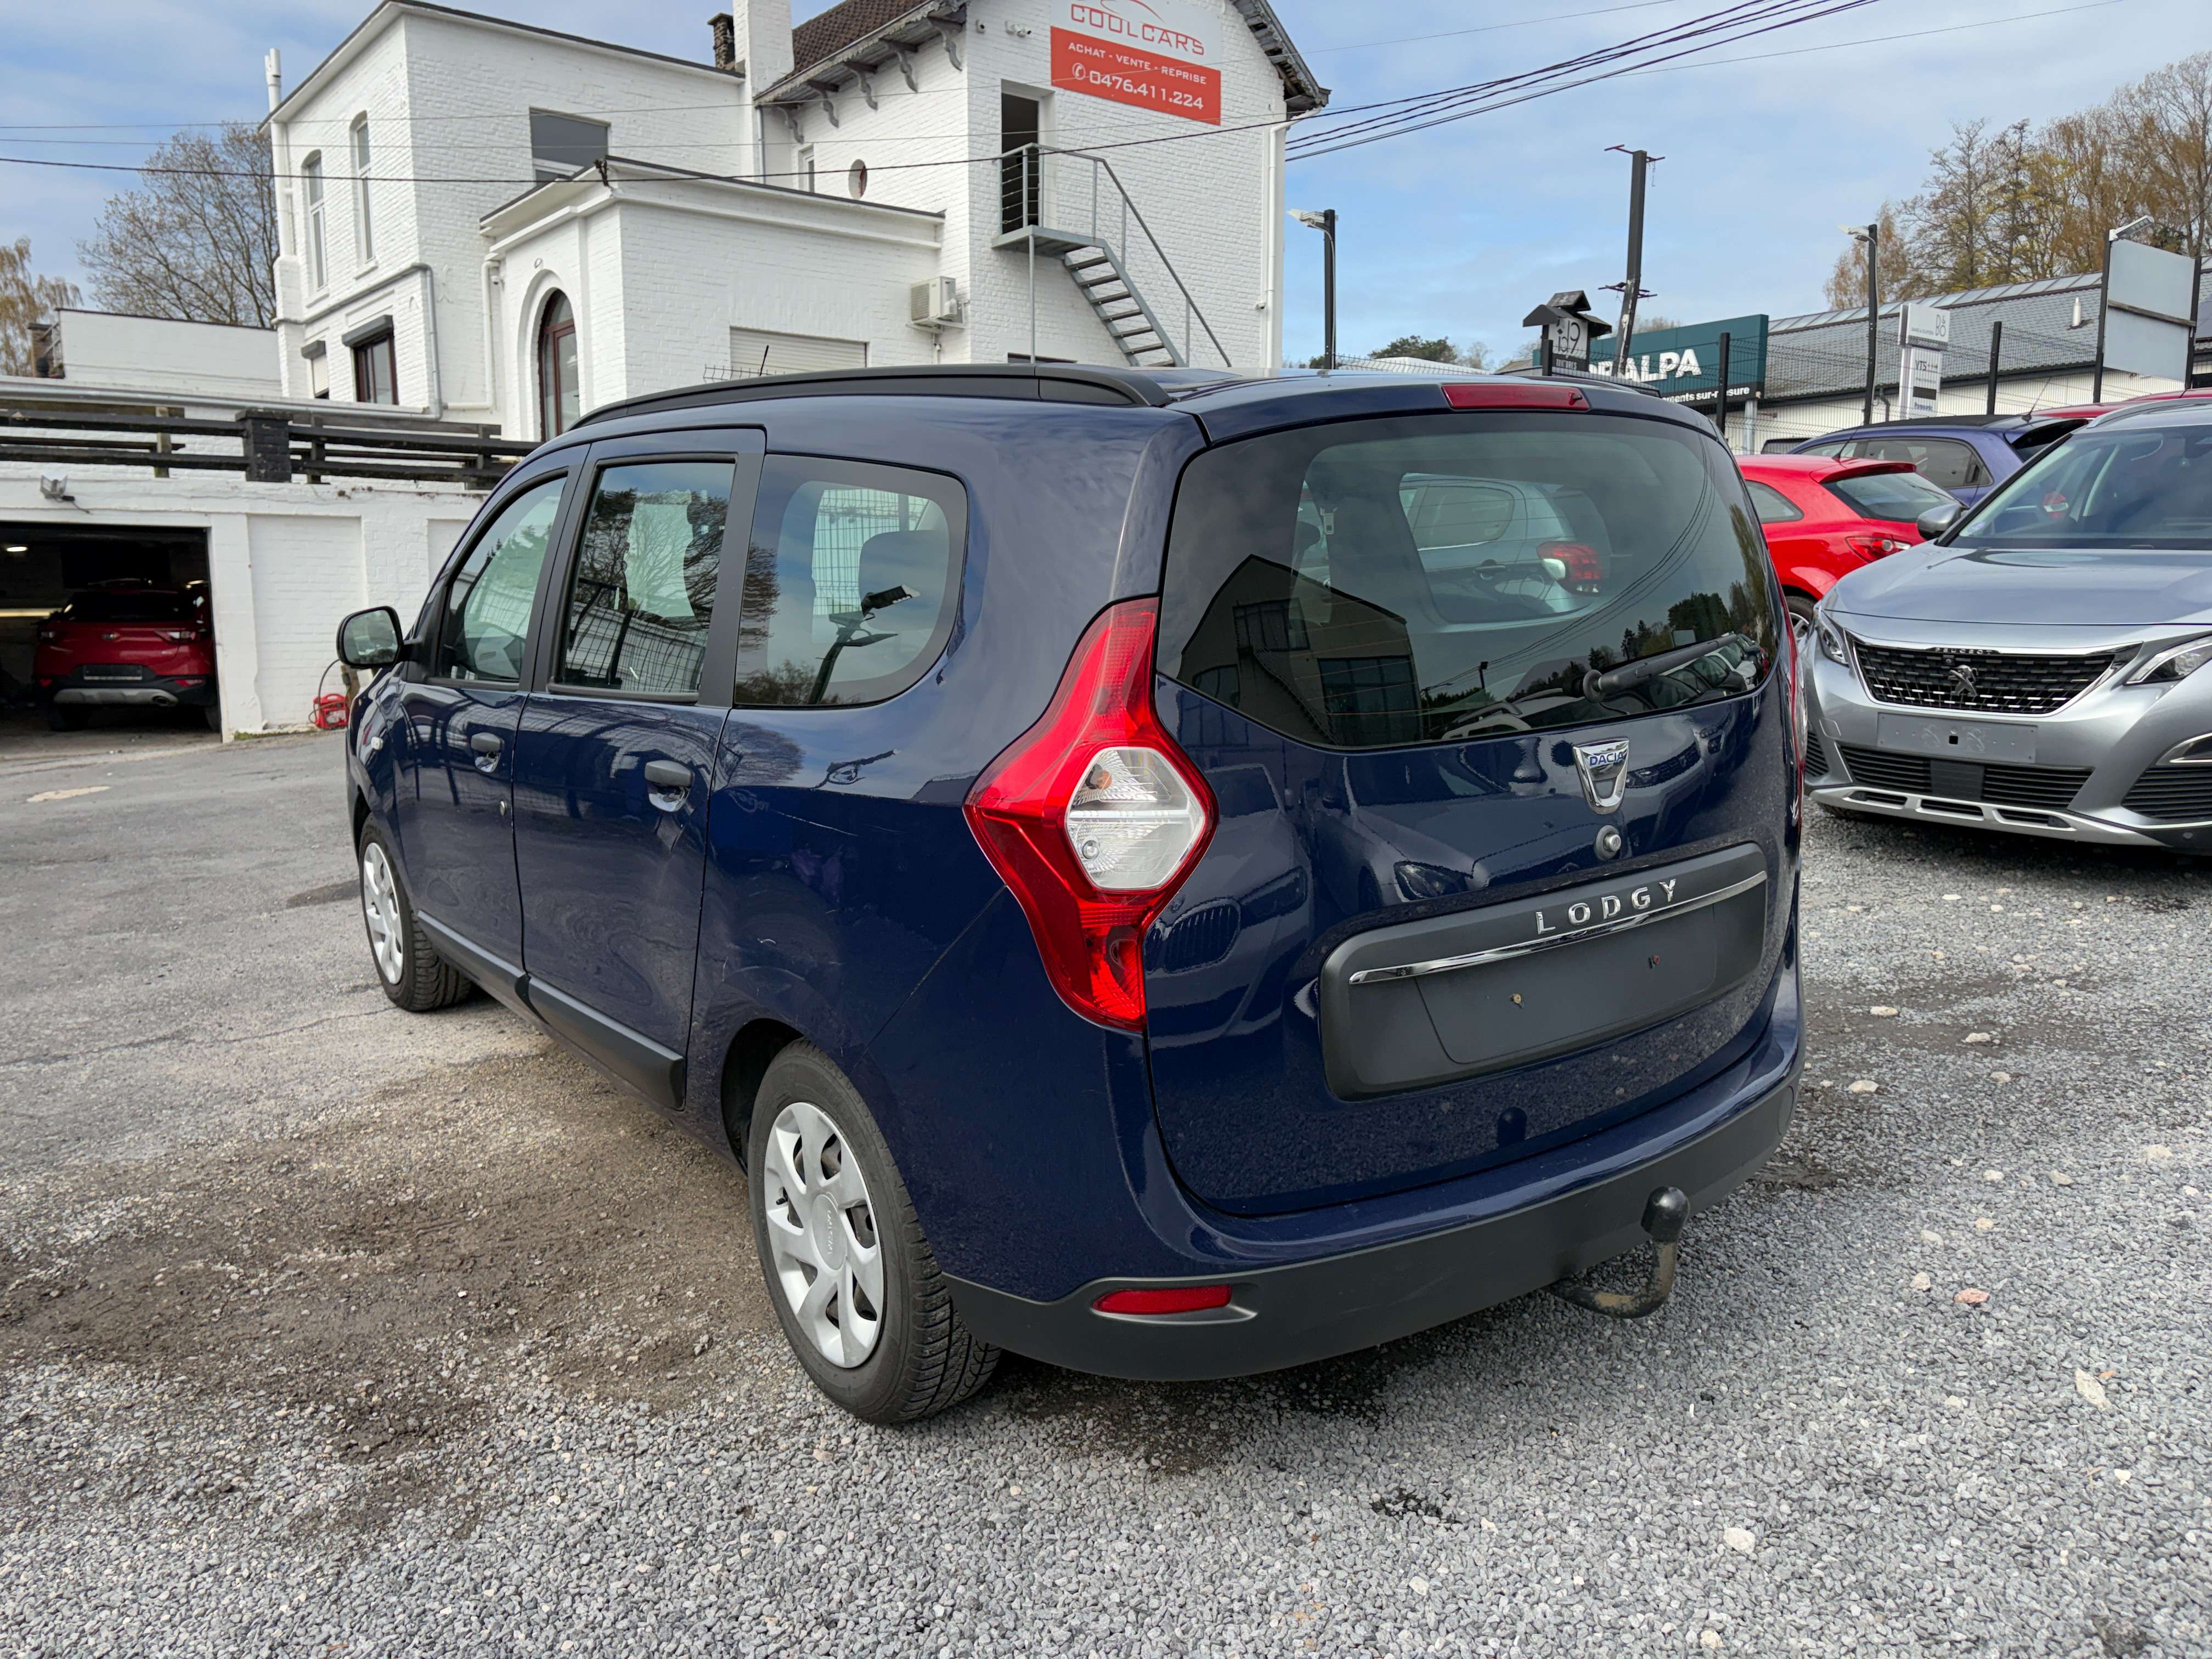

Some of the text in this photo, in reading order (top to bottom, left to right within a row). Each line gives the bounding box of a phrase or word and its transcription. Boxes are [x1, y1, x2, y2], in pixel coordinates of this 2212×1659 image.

[1071, 4, 1204, 55] COOLCARS
[1068, 42, 1106, 58] ACHAT
[1115, 54, 1151, 70] VENTE
[1161, 65, 1206, 84] REPRISE
[1089, 70, 1204, 110] 0476.411.224
[1589, 348, 1702, 383] ALPA
[1696, 387, 1750, 401] sur-sure
[1589, 751, 1625, 766] DACIA
[1536, 879, 1677, 934] LODGY
